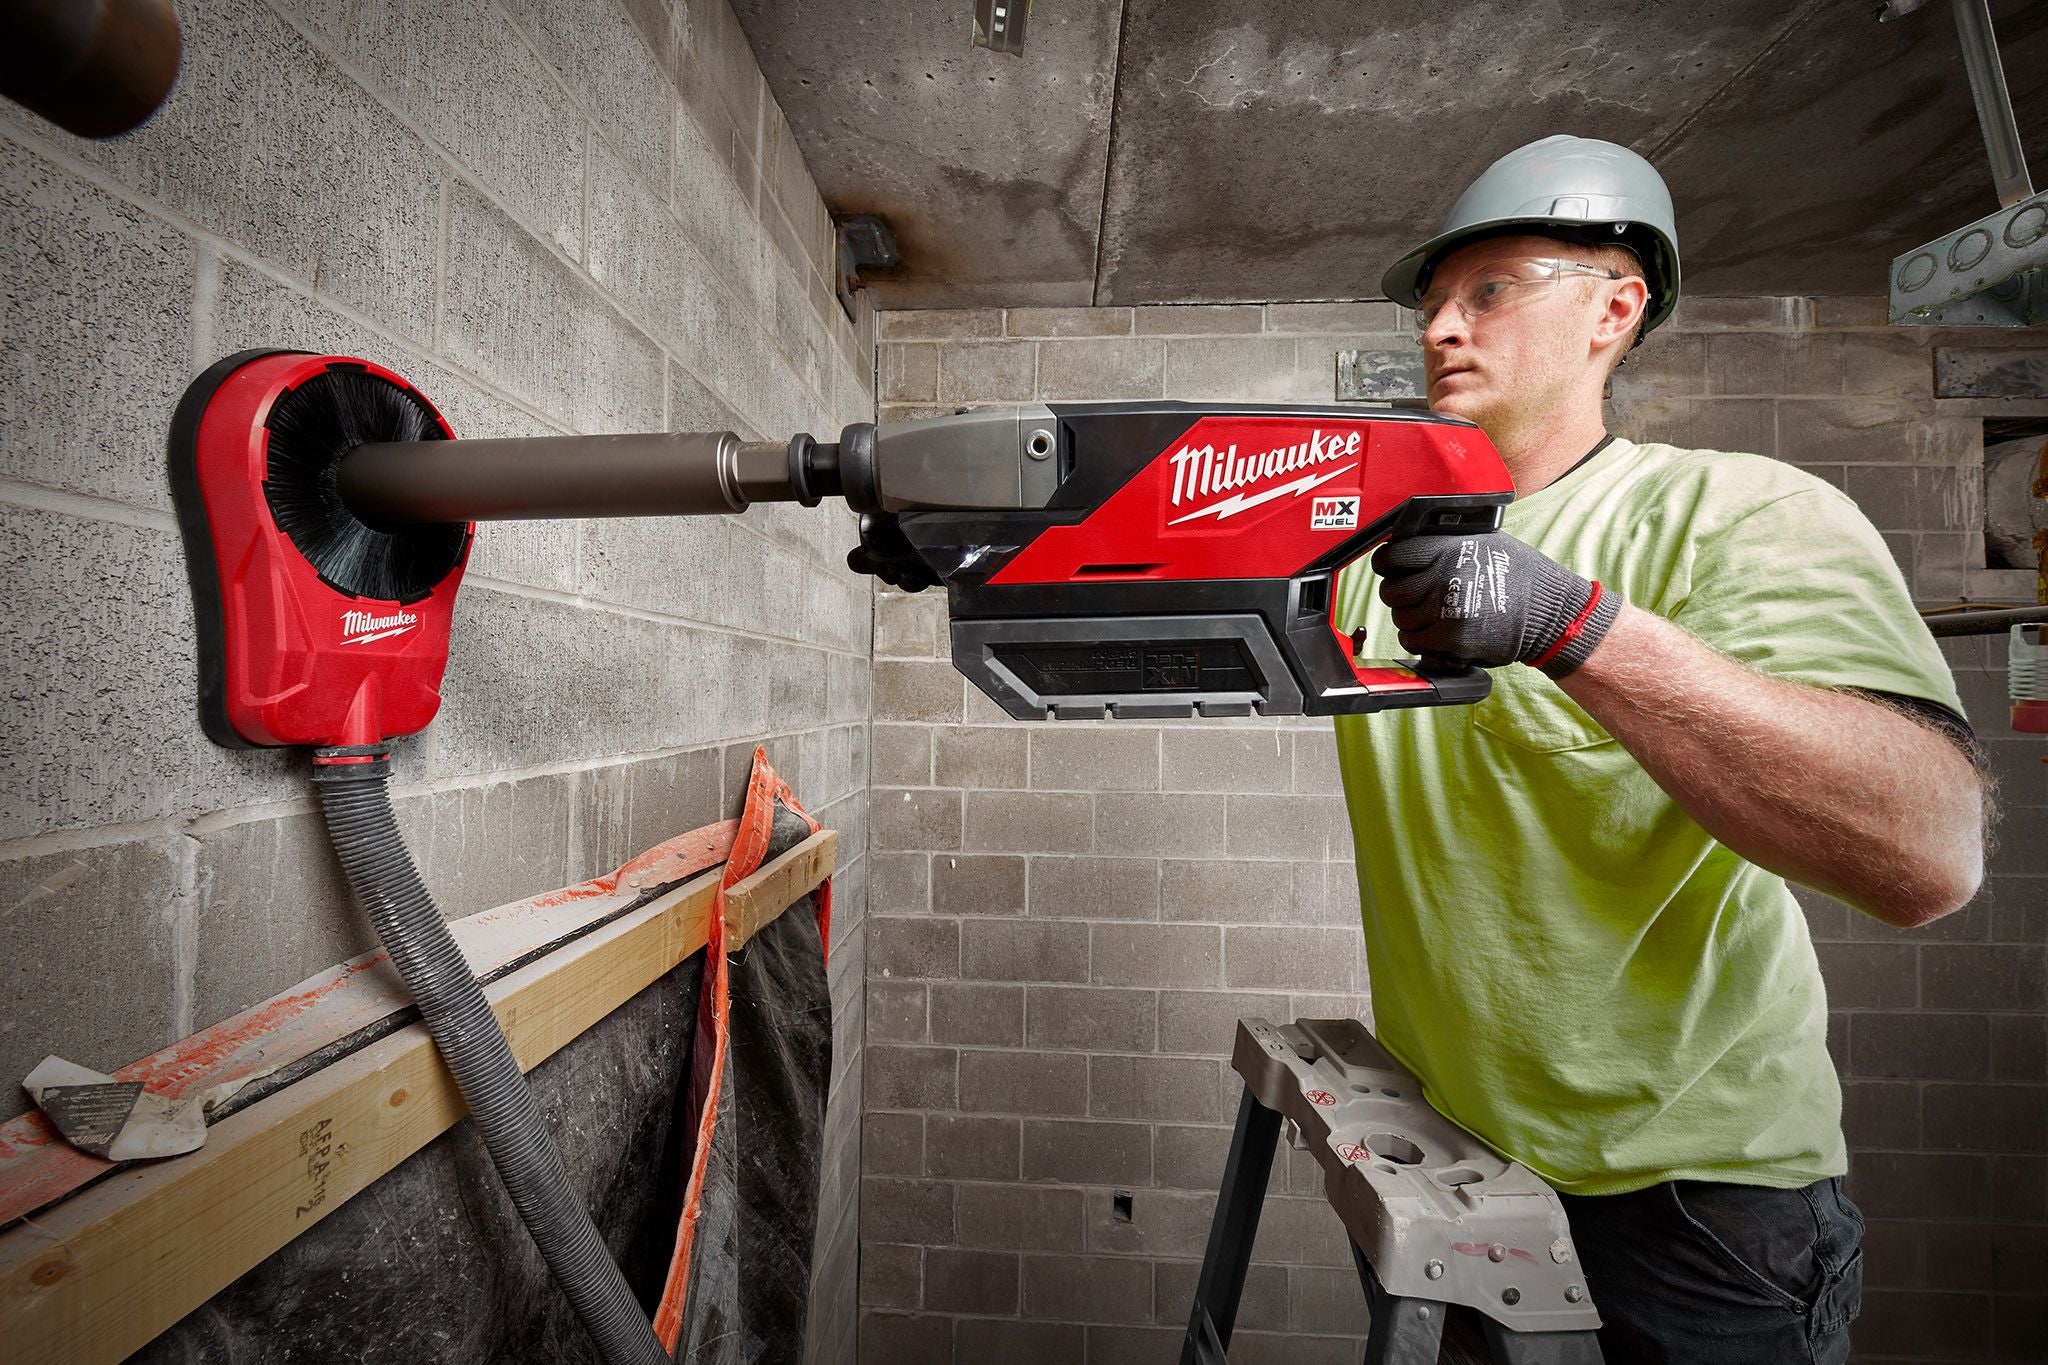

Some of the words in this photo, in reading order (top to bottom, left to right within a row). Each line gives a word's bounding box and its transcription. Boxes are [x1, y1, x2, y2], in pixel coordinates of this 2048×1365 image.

[1169, 429, 1361, 507] Milwaukee
[1315, 501, 1356, 516] MX
[1314, 518, 1355, 526] FUEL
[1492, 549, 1510, 614] Milwaukee
[340, 610, 418, 637] Milwaukee
[296, 1200, 313, 1219] 2
